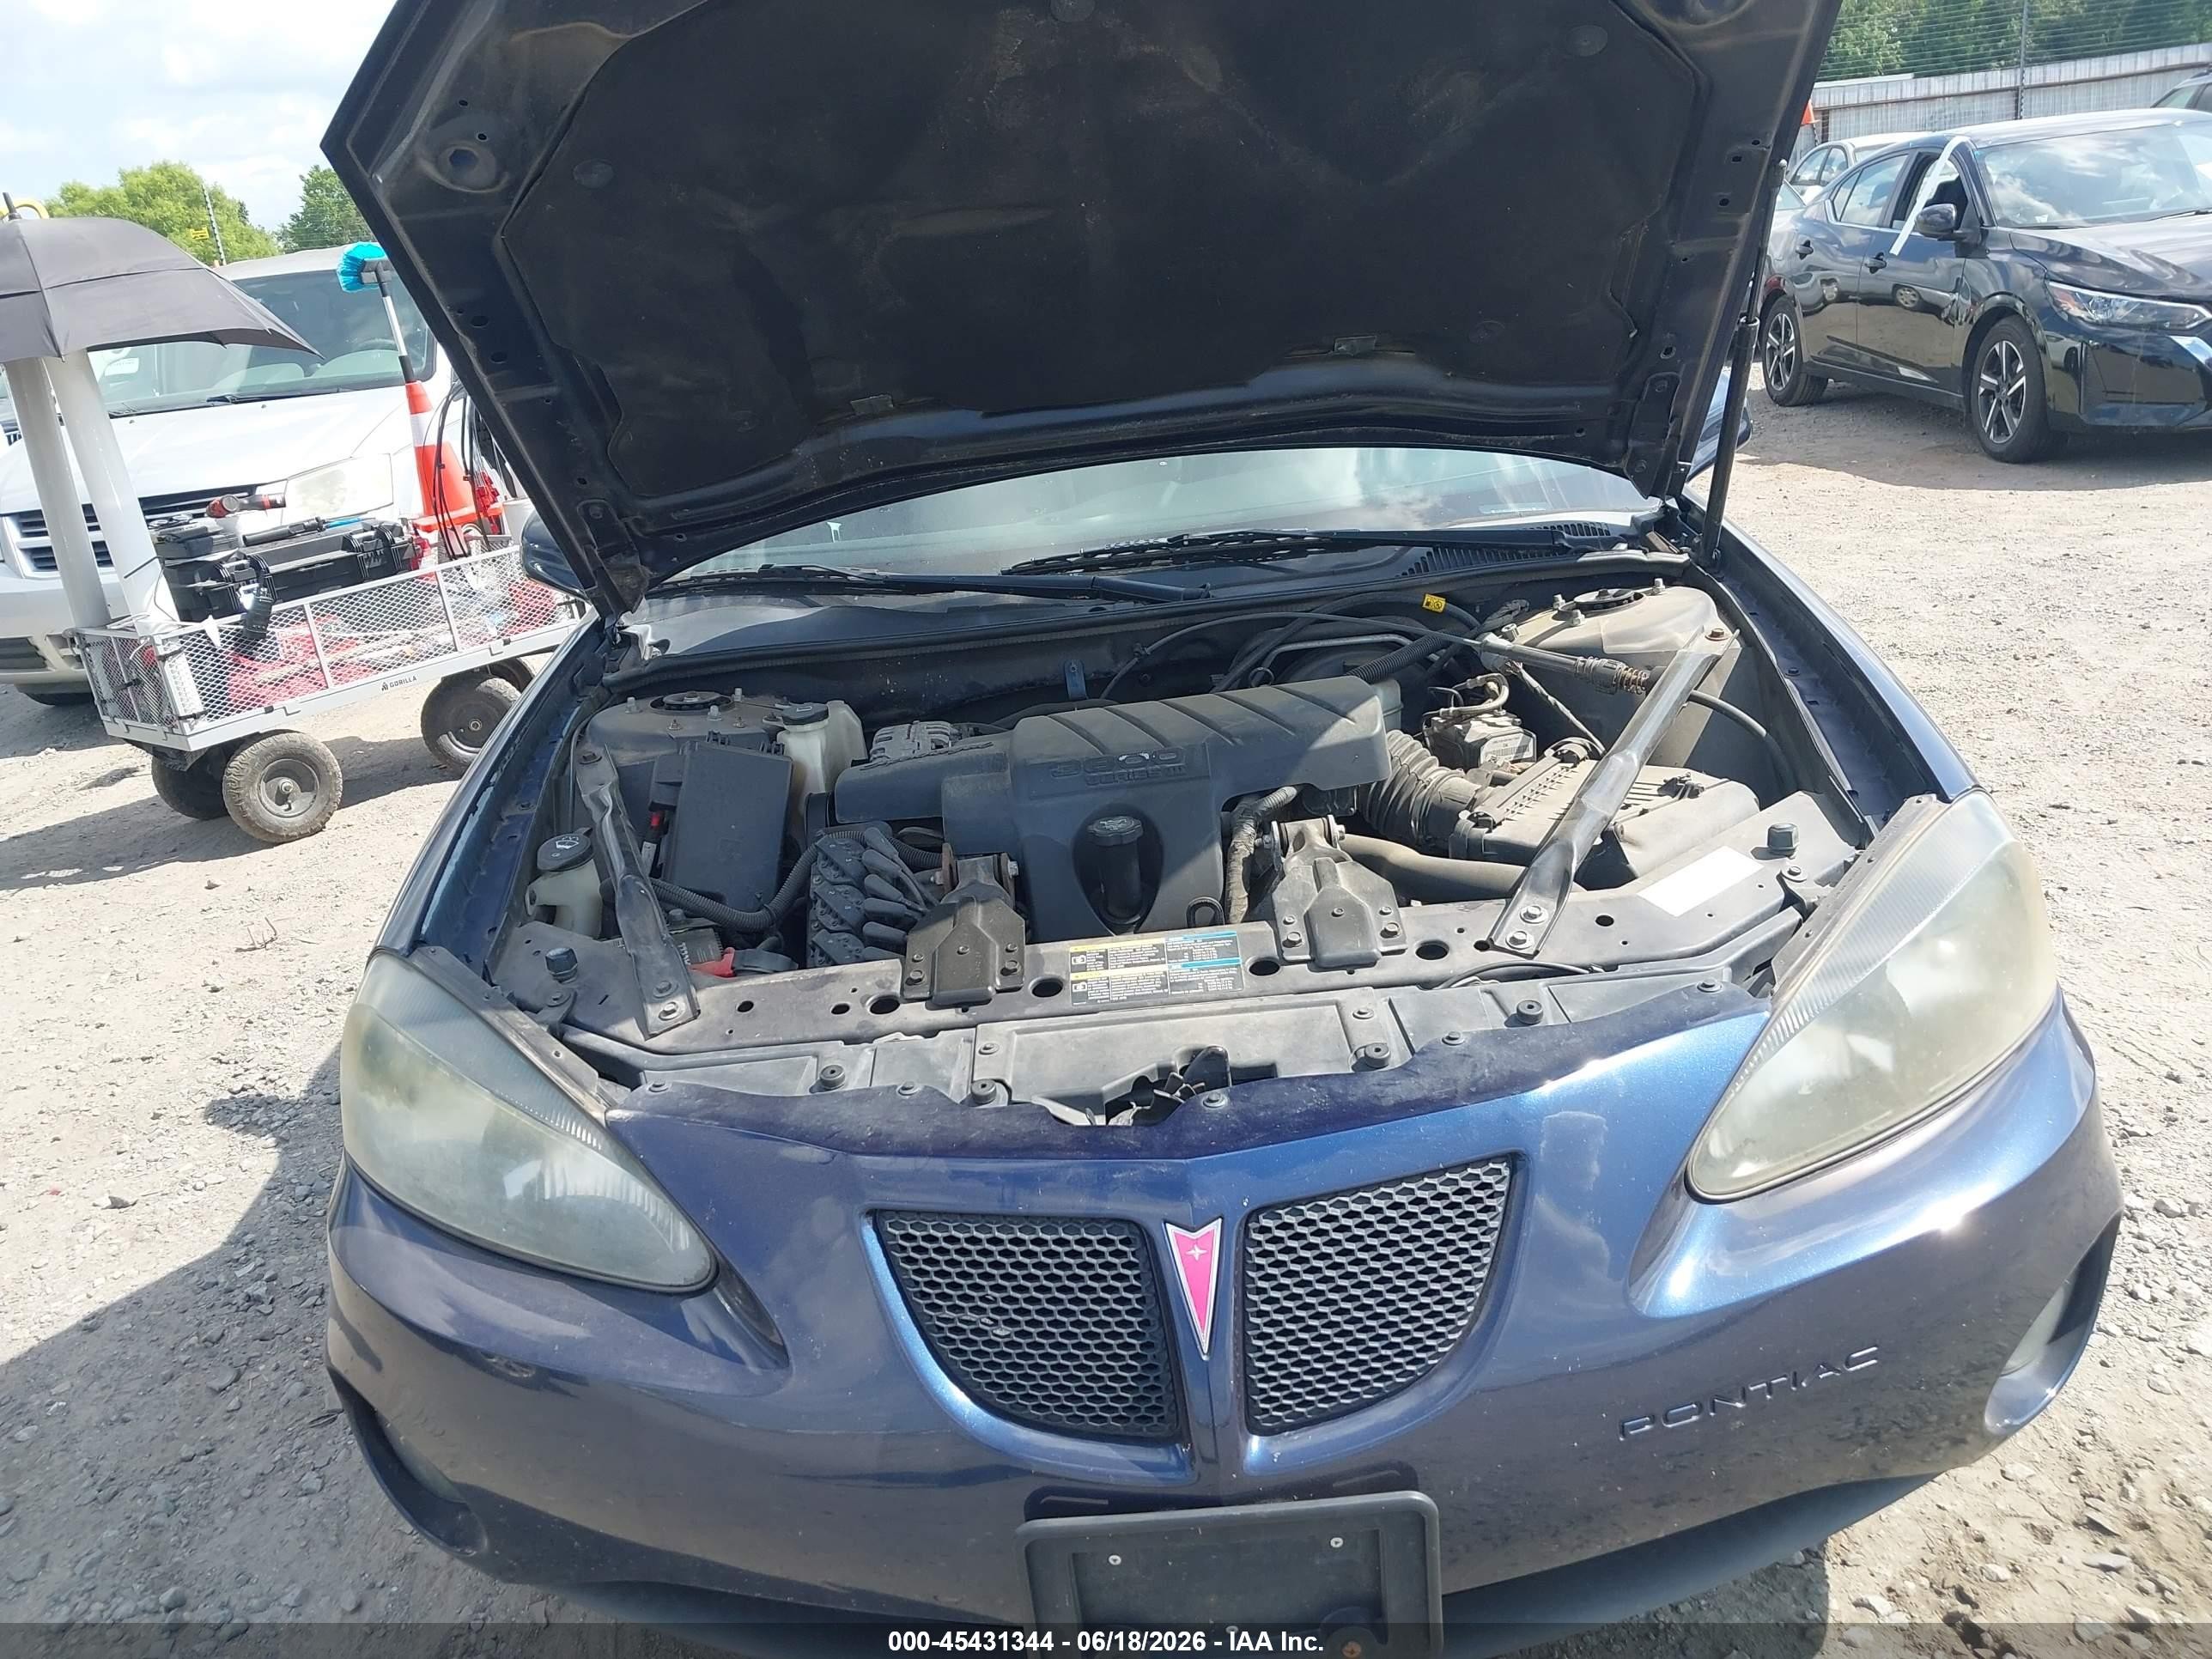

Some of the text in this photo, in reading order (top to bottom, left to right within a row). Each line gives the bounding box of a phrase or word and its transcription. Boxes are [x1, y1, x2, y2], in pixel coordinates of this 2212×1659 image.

[389, 675, 417, 688] GORILLA
[1049, 748, 1185, 778] 3800
[1085, 768, 1161, 787] SERIES
[1619, 1346, 1879, 1441] PONTIAC
